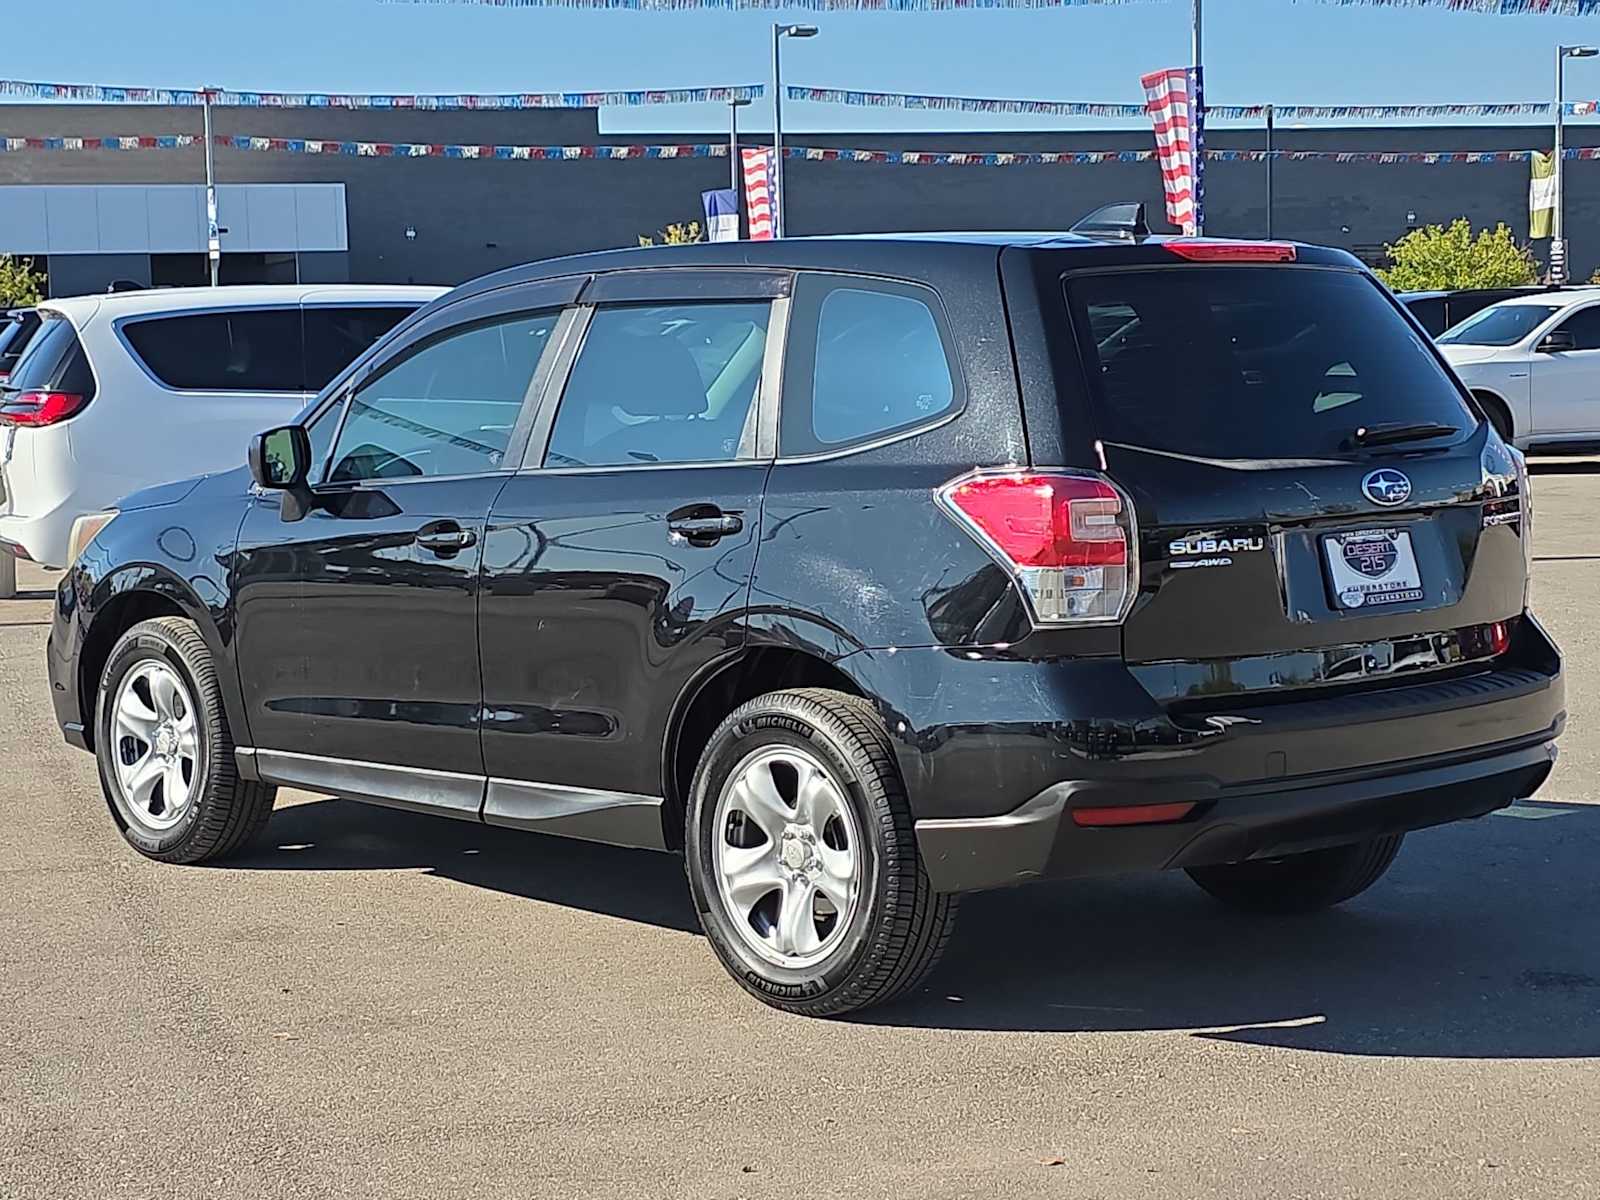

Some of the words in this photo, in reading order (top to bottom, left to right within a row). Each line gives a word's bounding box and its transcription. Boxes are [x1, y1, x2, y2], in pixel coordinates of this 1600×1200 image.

[1169, 538, 1263, 555] SUBARU
[1346, 542, 1391, 556] DESERT
[1194, 558, 1233, 568] AWD
[1360, 555, 1386, 572] 215
[756, 717, 813, 738] MICHELIN
